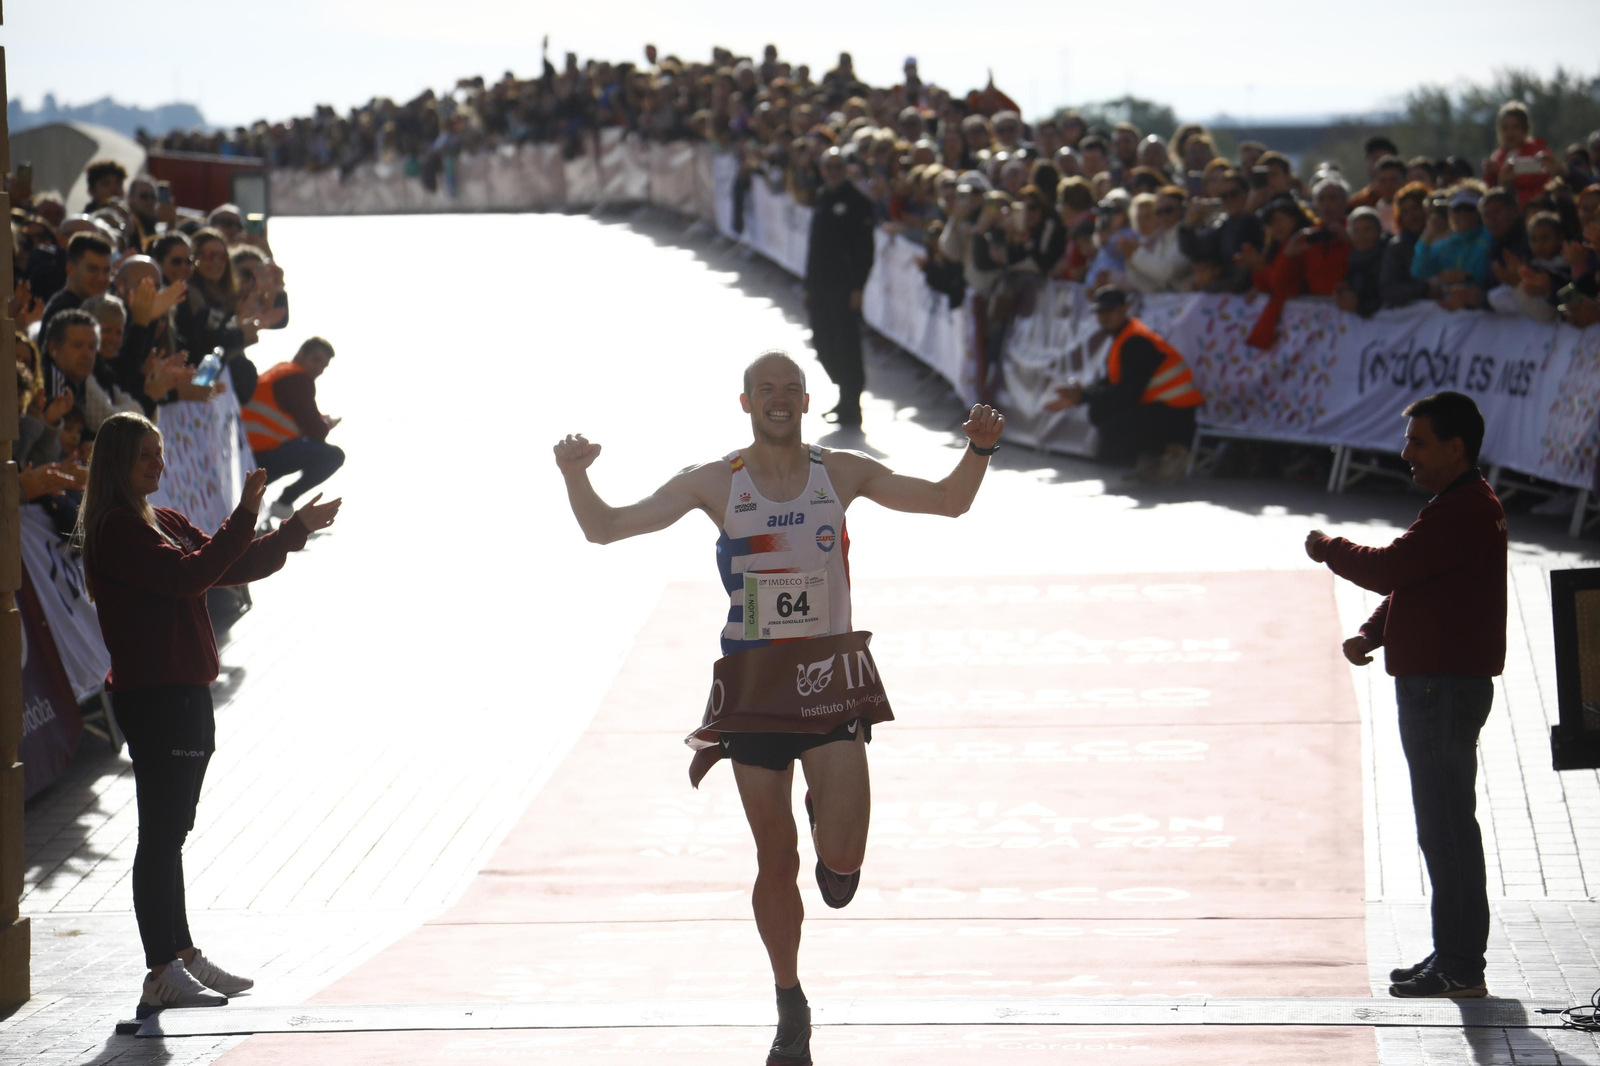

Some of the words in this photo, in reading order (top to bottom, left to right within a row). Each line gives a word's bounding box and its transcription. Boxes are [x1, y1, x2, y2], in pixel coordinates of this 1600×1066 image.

[1465, 354, 1495, 392] ES
[767, 511, 805, 527] aula
[768, 578, 803, 586] IMDECO
[776, 591, 810, 618] 64
[886, 687, 1212, 704] MDECO
[800, 703, 844, 717] Instituto
[172, 749, 205, 757] GIVOVA
[868, 740, 1210, 756] MDECO
[872, 800, 1058, 818] EDIA
[868, 813, 1224, 834] ARATÓN
[866, 836, 1082, 849] RDOBA
[1094, 835, 1237, 848] 2022
[858, 887, 1192, 903] DECO
[996, 1042, 1151, 1051] Córdoba
